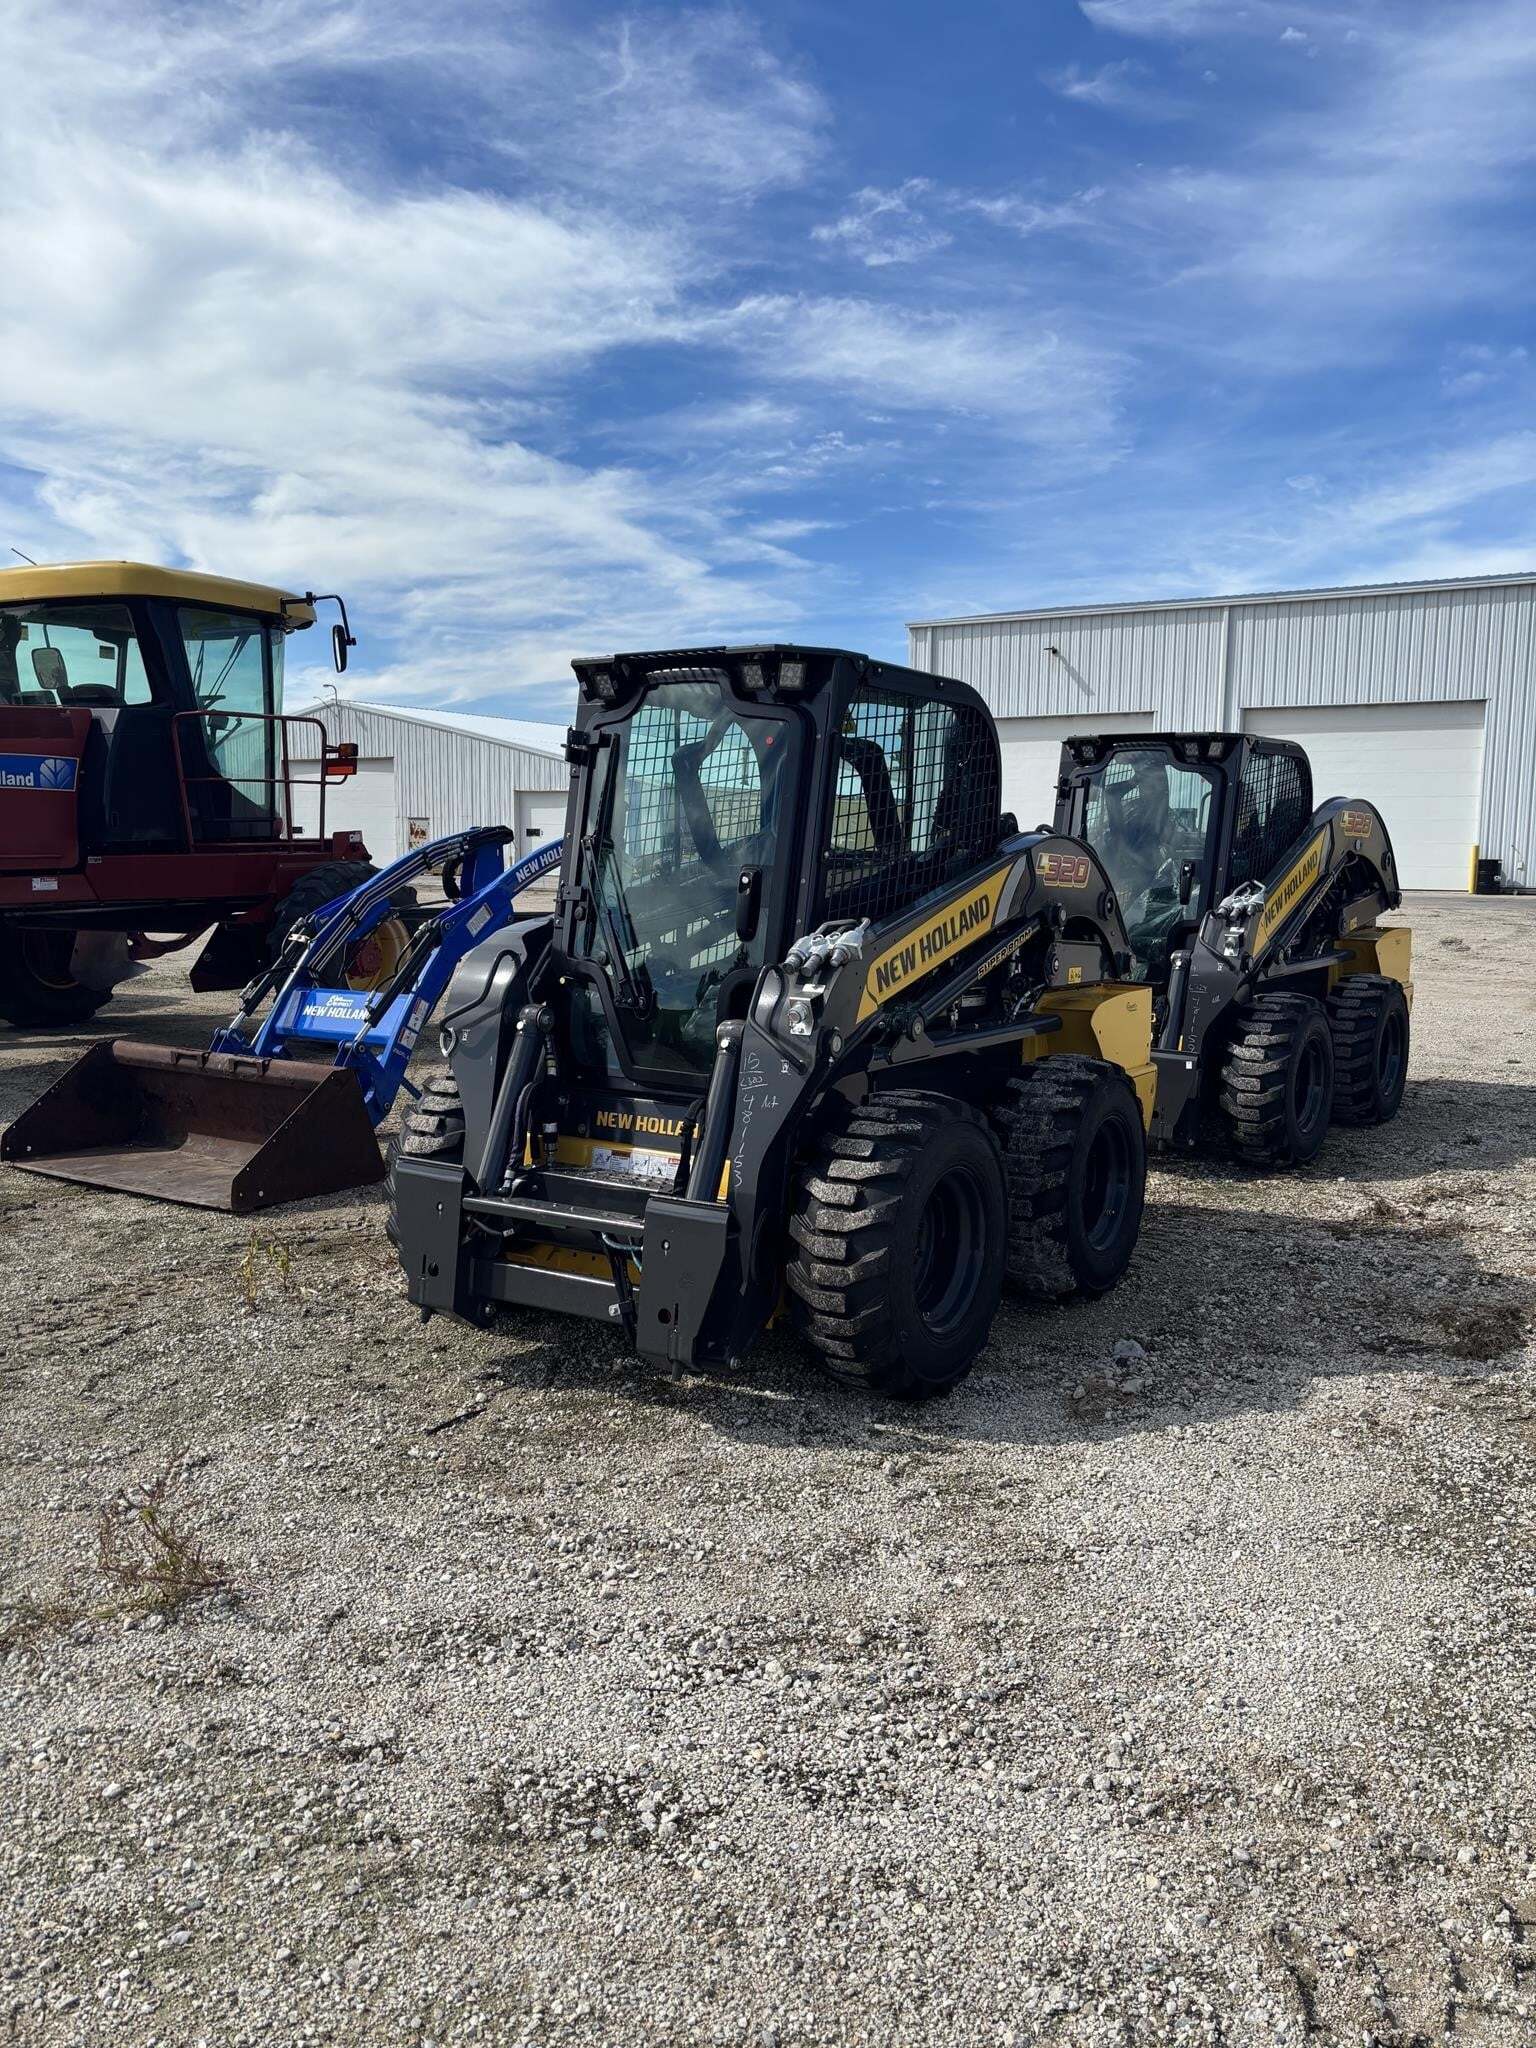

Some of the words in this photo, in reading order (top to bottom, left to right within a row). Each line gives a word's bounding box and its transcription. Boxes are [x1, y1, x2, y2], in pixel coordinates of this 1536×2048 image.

[515, 859, 540, 883] NEW
[540, 846, 563, 867] HOLL
[1036, 853, 1090, 888] L320
[1263, 892, 1284, 928] NEW
[1283, 850, 1319, 901] HOLLAND
[875, 942, 917, 993] NEW
[919, 894, 991, 964] HOLLAND
[303, 1004, 326, 1017] NEW
[326, 1006, 369, 1020] HOLLAN
[596, 1110, 633, 1130] NEW
